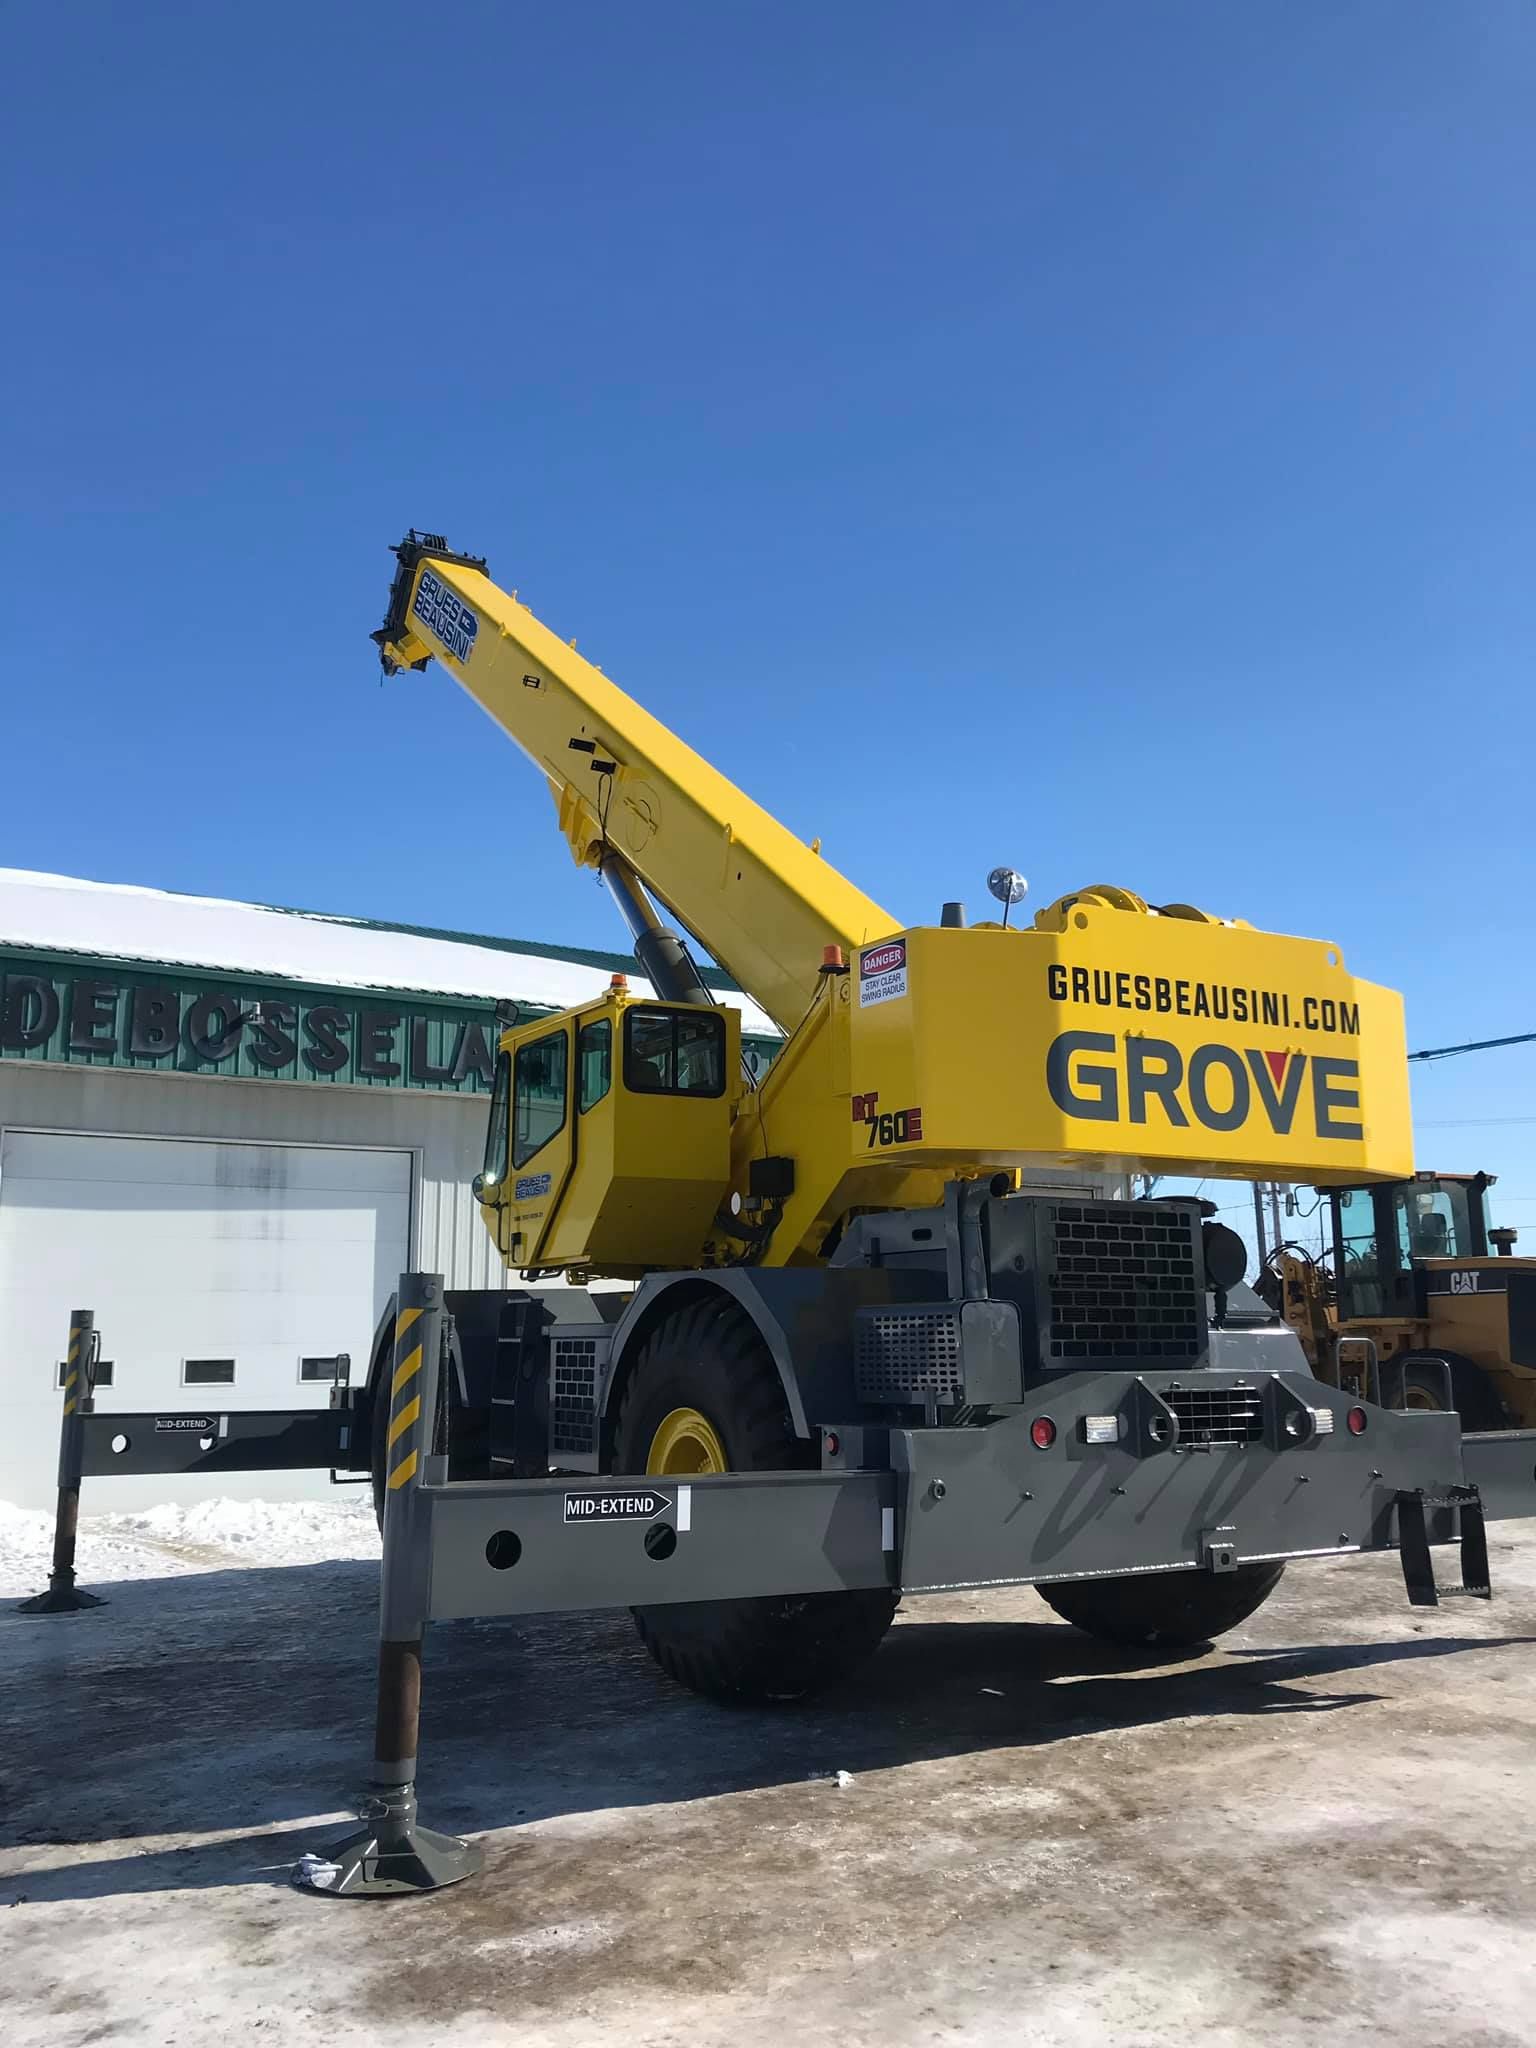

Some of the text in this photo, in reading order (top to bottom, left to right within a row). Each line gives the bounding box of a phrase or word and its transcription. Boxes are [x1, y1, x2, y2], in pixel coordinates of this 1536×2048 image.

[420, 571, 460, 622] GRUES
[414, 589, 470, 661] BEAUSINI
[863, 949, 901, 971] DANGER
[861, 982, 906, 1003] SWING RADIUS
[865, 972, 902, 991] STAY CLEAR
[1048, 964, 1360, 1036] GRUESBEAUSINI.COM
[1046, 1030, 1364, 1140] GROVE
[852, 1091, 879, 1122] RT
[864, 1107, 923, 1148] 760E
[1450, 1271, 1480, 1294] CAT
[567, 1498, 654, 1515] MID-EXTEND
